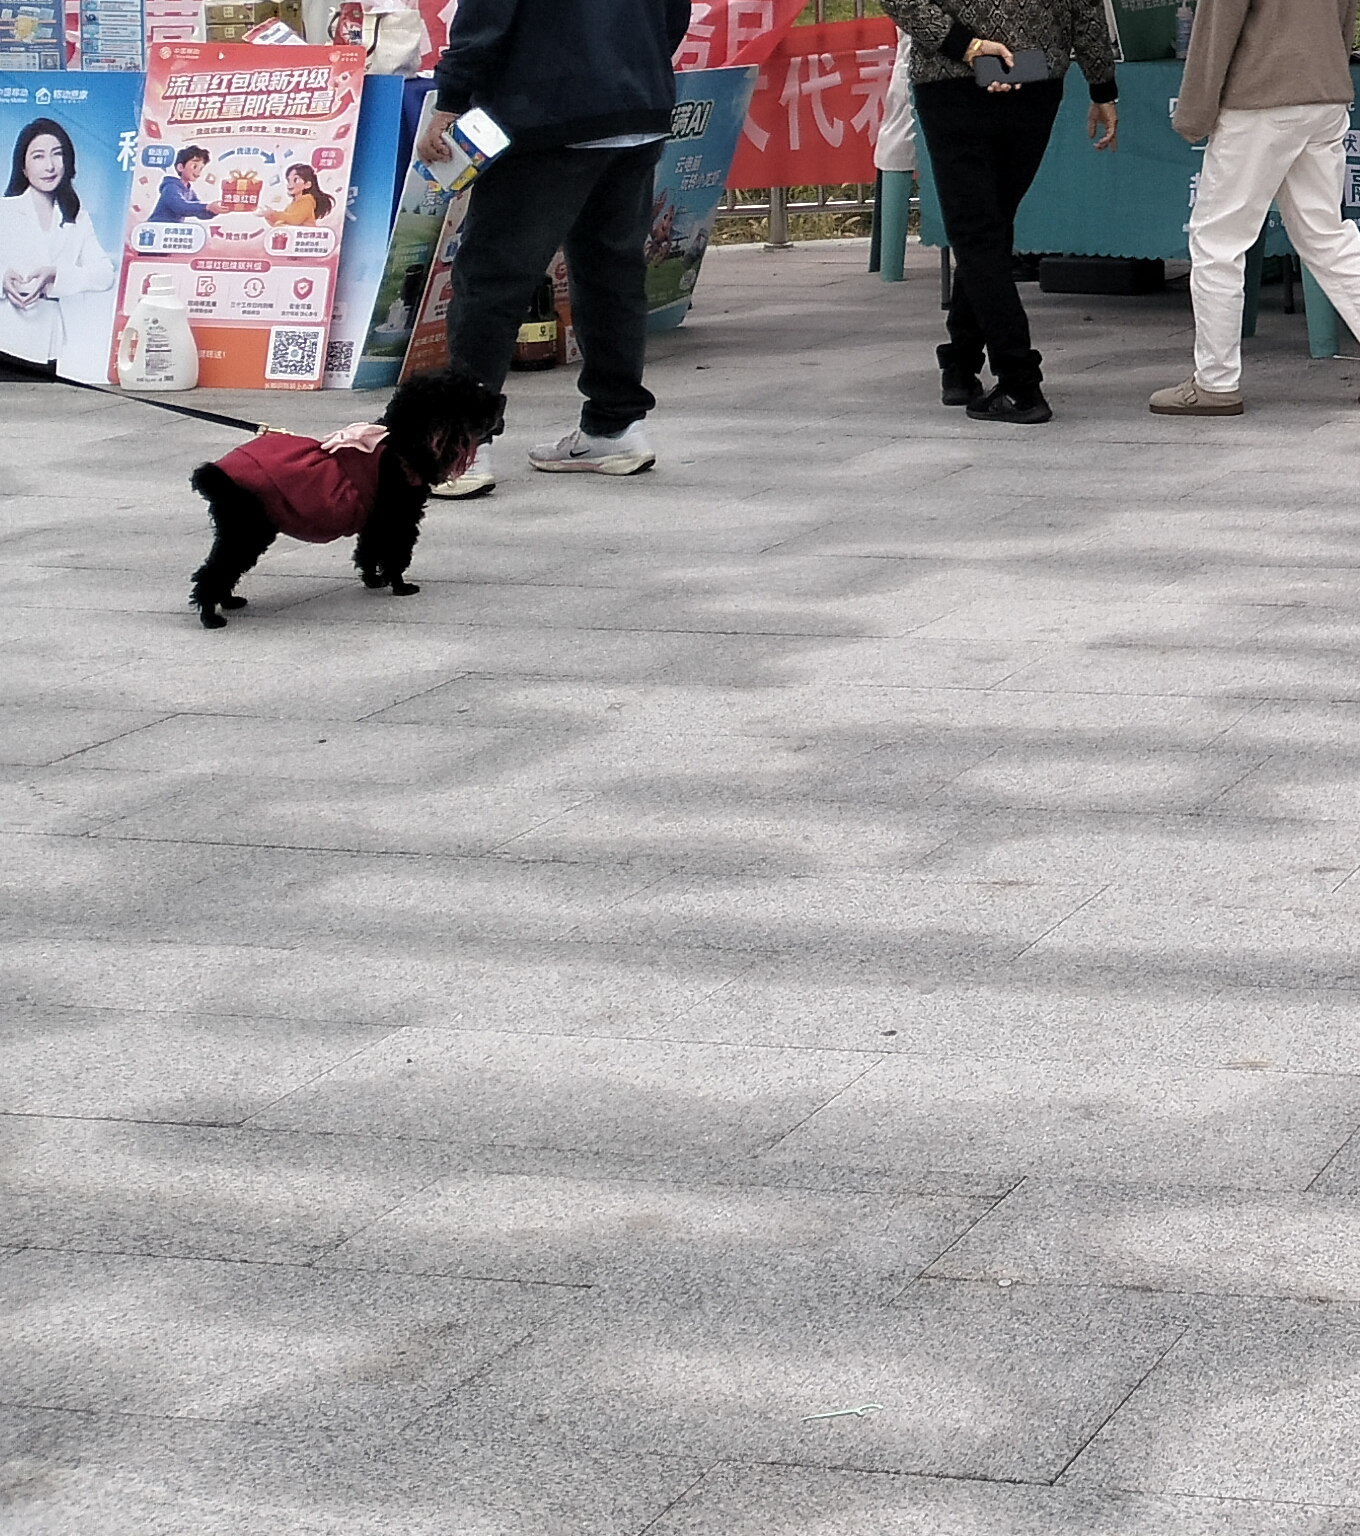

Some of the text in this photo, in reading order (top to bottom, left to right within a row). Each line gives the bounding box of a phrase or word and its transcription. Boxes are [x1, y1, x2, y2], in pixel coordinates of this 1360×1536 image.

[166, 68, 330, 96] 流量红包焕新升级
[171, 91, 334, 121] 赠流量即得流量
